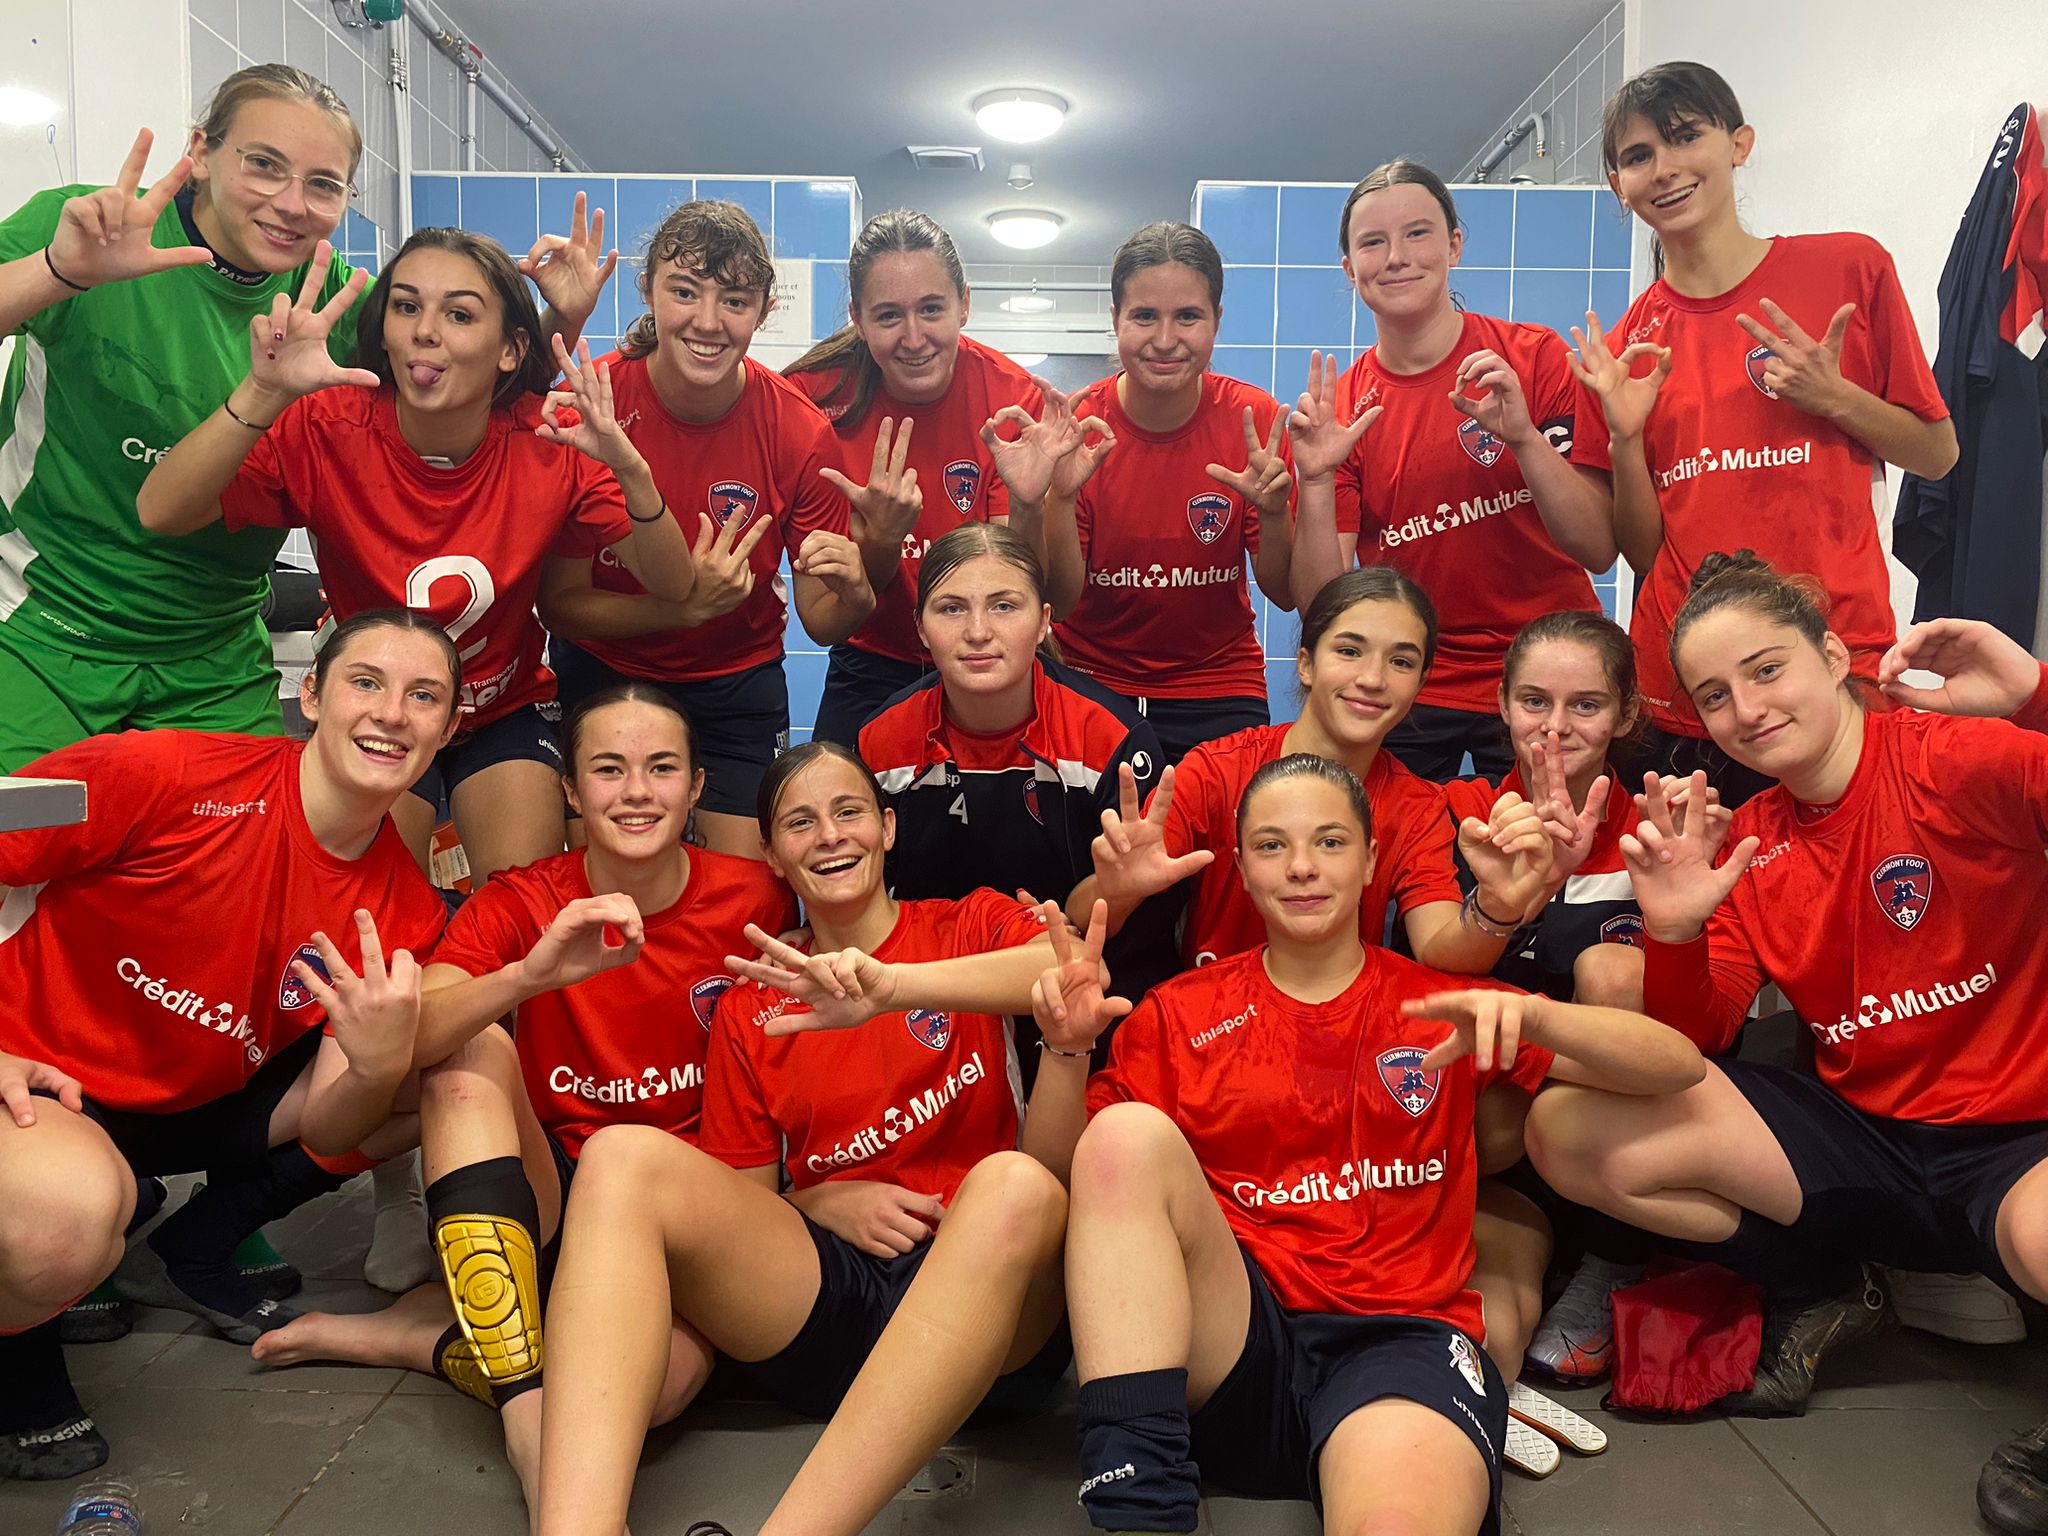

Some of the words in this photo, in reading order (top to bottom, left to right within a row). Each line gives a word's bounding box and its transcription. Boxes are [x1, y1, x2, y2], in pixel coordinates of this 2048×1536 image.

[121, 437, 172, 465] Cré
[1544, 425, 1574, 453] C
[1482, 453, 1494, 462] 63
[1721, 441, 1811, 471] Mutuel
[713, 483, 741, 493] CLERMONT
[741, 486, 755, 499] FOOT
[959, 500, 970, 509] 63
[1459, 487, 1533, 524] Mutue
[1202, 532, 1213, 541] 63
[1088, 567, 1141, 588] rédit
[1171, 564, 1240, 588] Mutue
[948, 792, 969, 825] 4
[1875, 858, 1905, 880] CLERMONT
[1905, 858, 1926, 870] FOOT
[1899, 912, 1915, 923] 63
[116, 957, 205, 1021] Crédit
[694, 979, 721, 995] CLERMONT
[1889, 962, 1998, 1020] Mutuel
[1190, 1002, 1258, 1049] uhlsport
[935, 1034, 946, 1046] 63
[1382, 1051, 1414, 1064] CLERMONT
[549, 1065, 636, 1104] Crédit
[1407, 1100, 1422, 1109] 63
[806, 1125, 887, 1174] Crédit
[1232, 1171, 1333, 1208] Crédit
